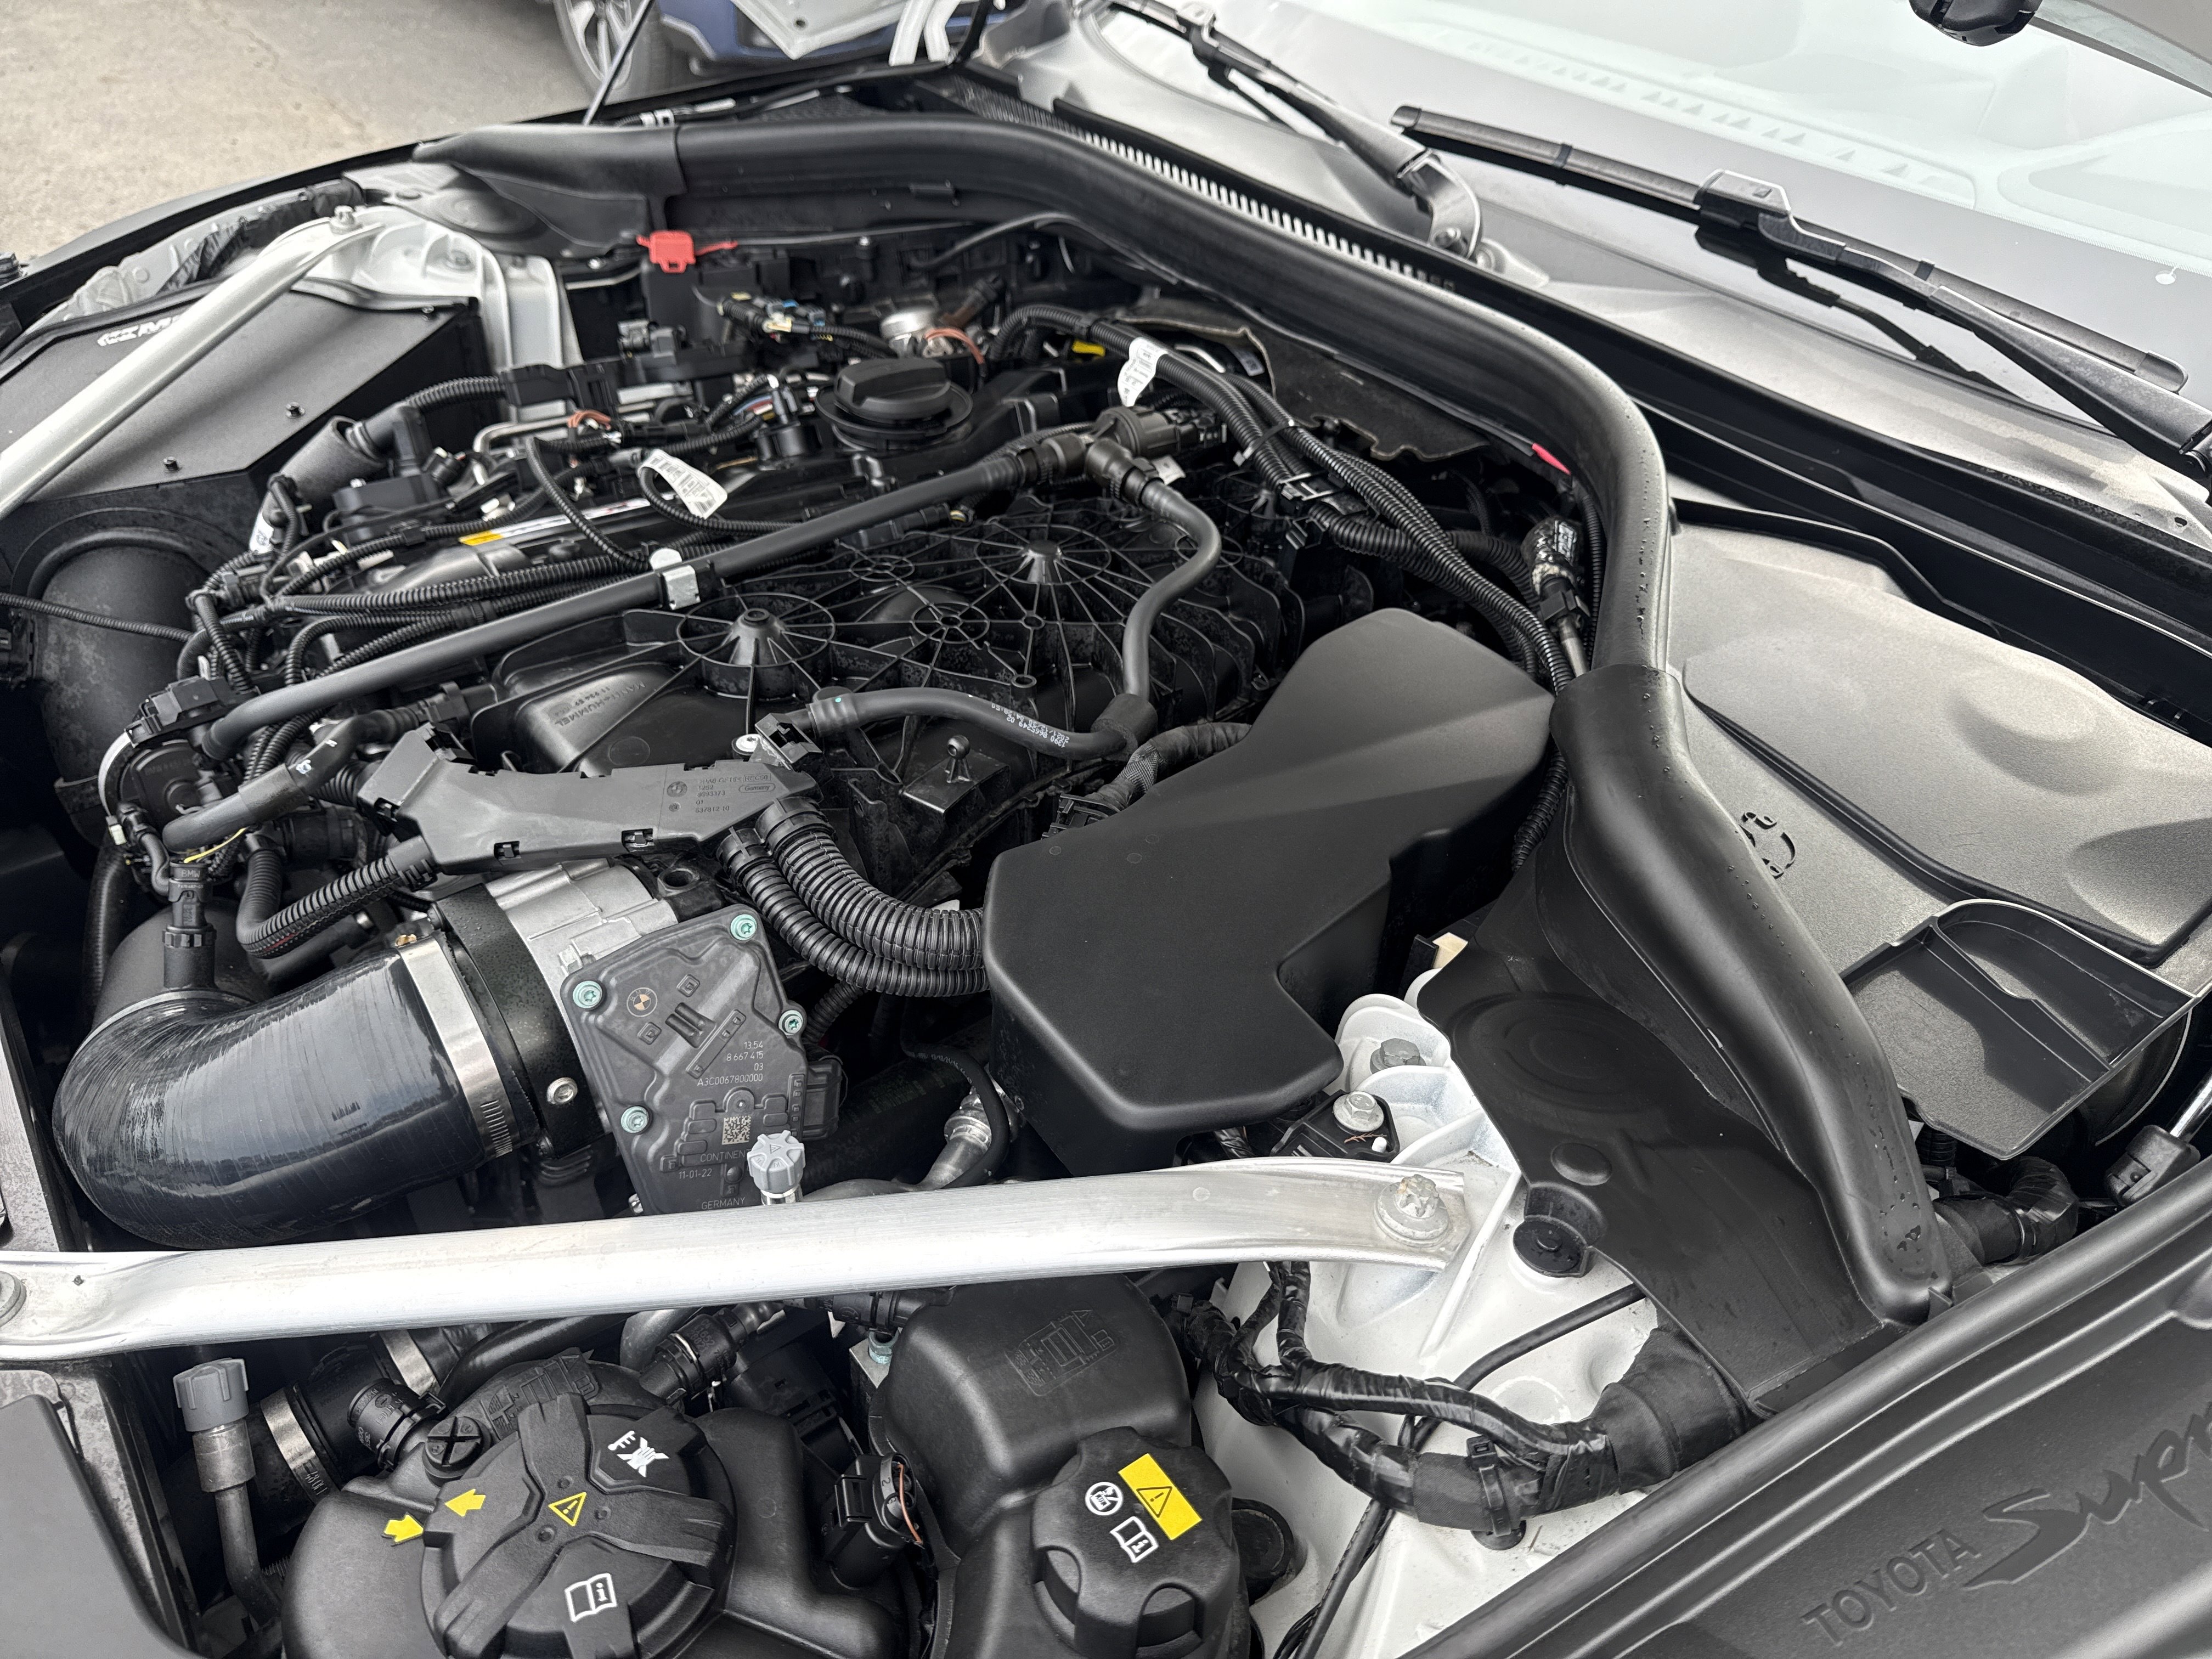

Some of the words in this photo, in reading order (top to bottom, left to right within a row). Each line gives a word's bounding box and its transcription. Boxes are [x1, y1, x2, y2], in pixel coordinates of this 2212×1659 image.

[554, 681, 646, 727] MANN+HUMMEL
[1018, 721, 1048, 738] 8665249
[1050, 735, 1065, 748] 1390
[181, 869, 201, 878] BMW
[743, 1040, 764, 1050] 13.54
[754, 1062, 764, 1071] 03
[697, 1073, 764, 1087] A3C0067800000
[678, 1168, 713, 1180] 11-01-22
[701, 1196, 746, 1210] GERMANY
[1799, 1527, 1982, 1647] TOYOTA
